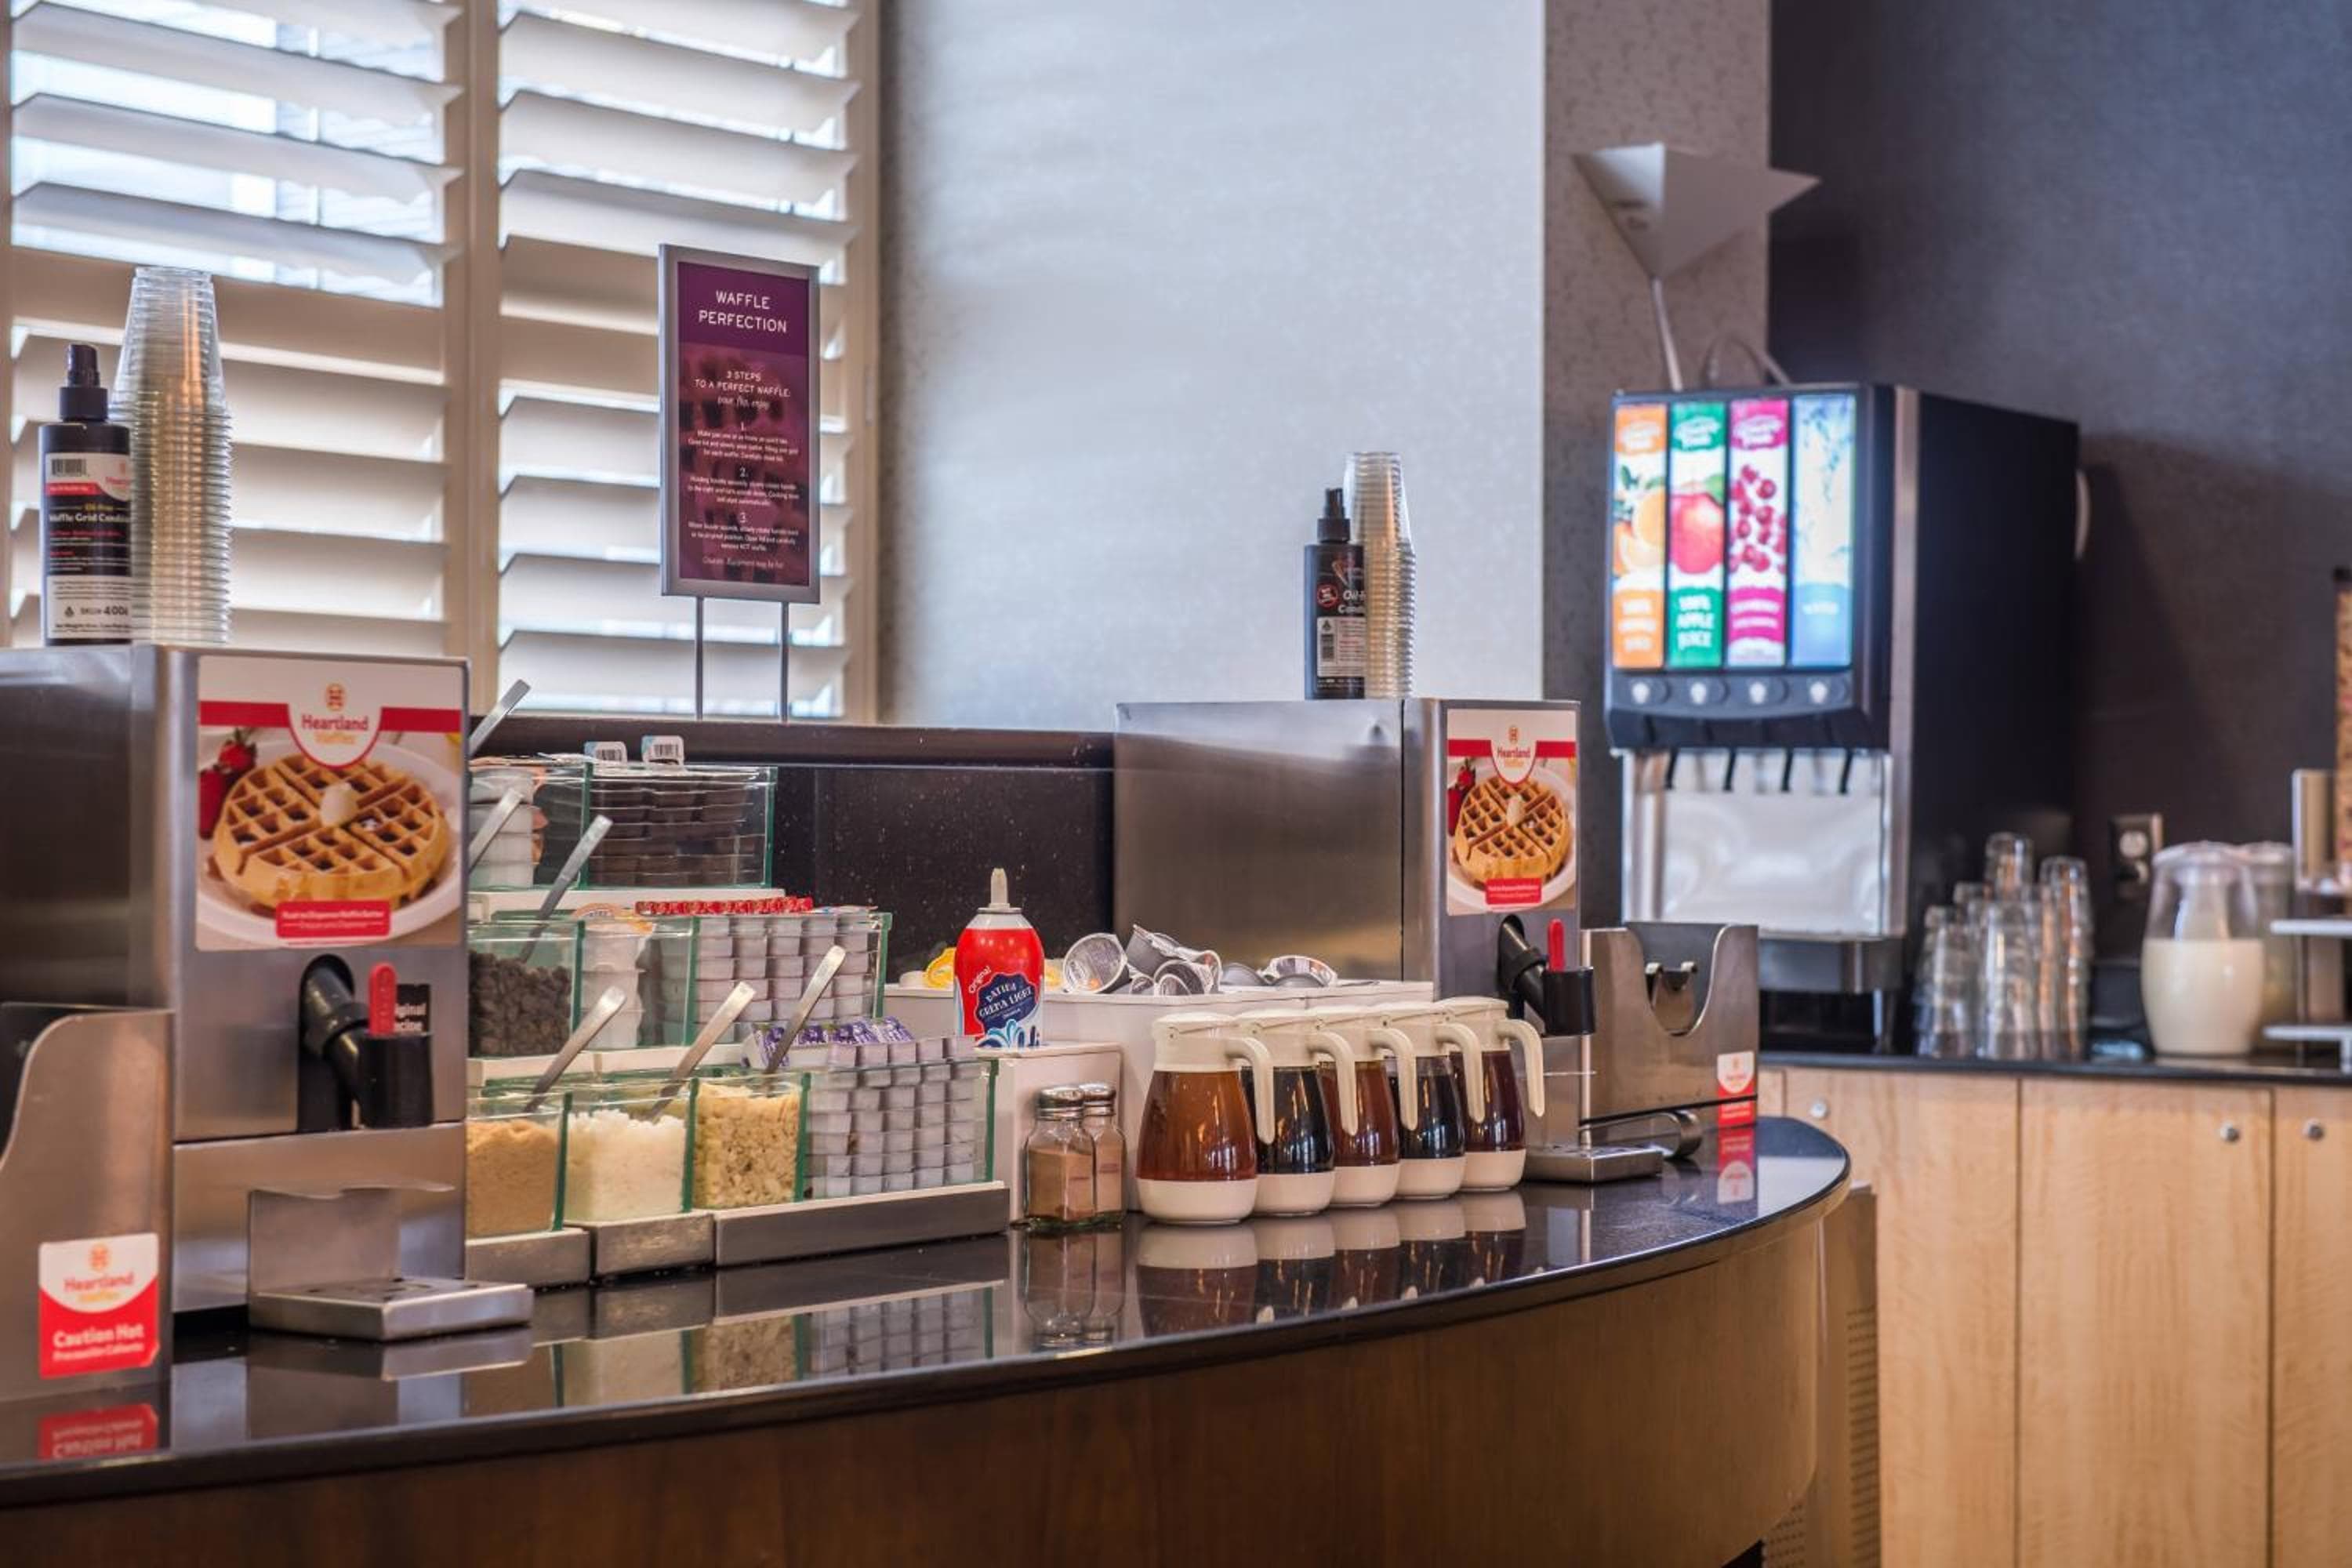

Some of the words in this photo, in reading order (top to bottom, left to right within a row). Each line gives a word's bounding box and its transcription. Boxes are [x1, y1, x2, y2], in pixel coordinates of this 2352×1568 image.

[716, 290, 771, 310] WAFFLE
[699, 310, 787, 333] PERFECTION
[734, 371, 761, 382] STEPS
[695, 379, 706, 388] TO
[708, 380, 714, 389] A
[717, 381, 755, 393] PERFECT
[301, 714, 369, 731] Heartland
[1497, 746, 1531, 758] Heartland
[63, 1271, 135, 1293] Heartland
[114, 1323, 144, 1340] Hot
